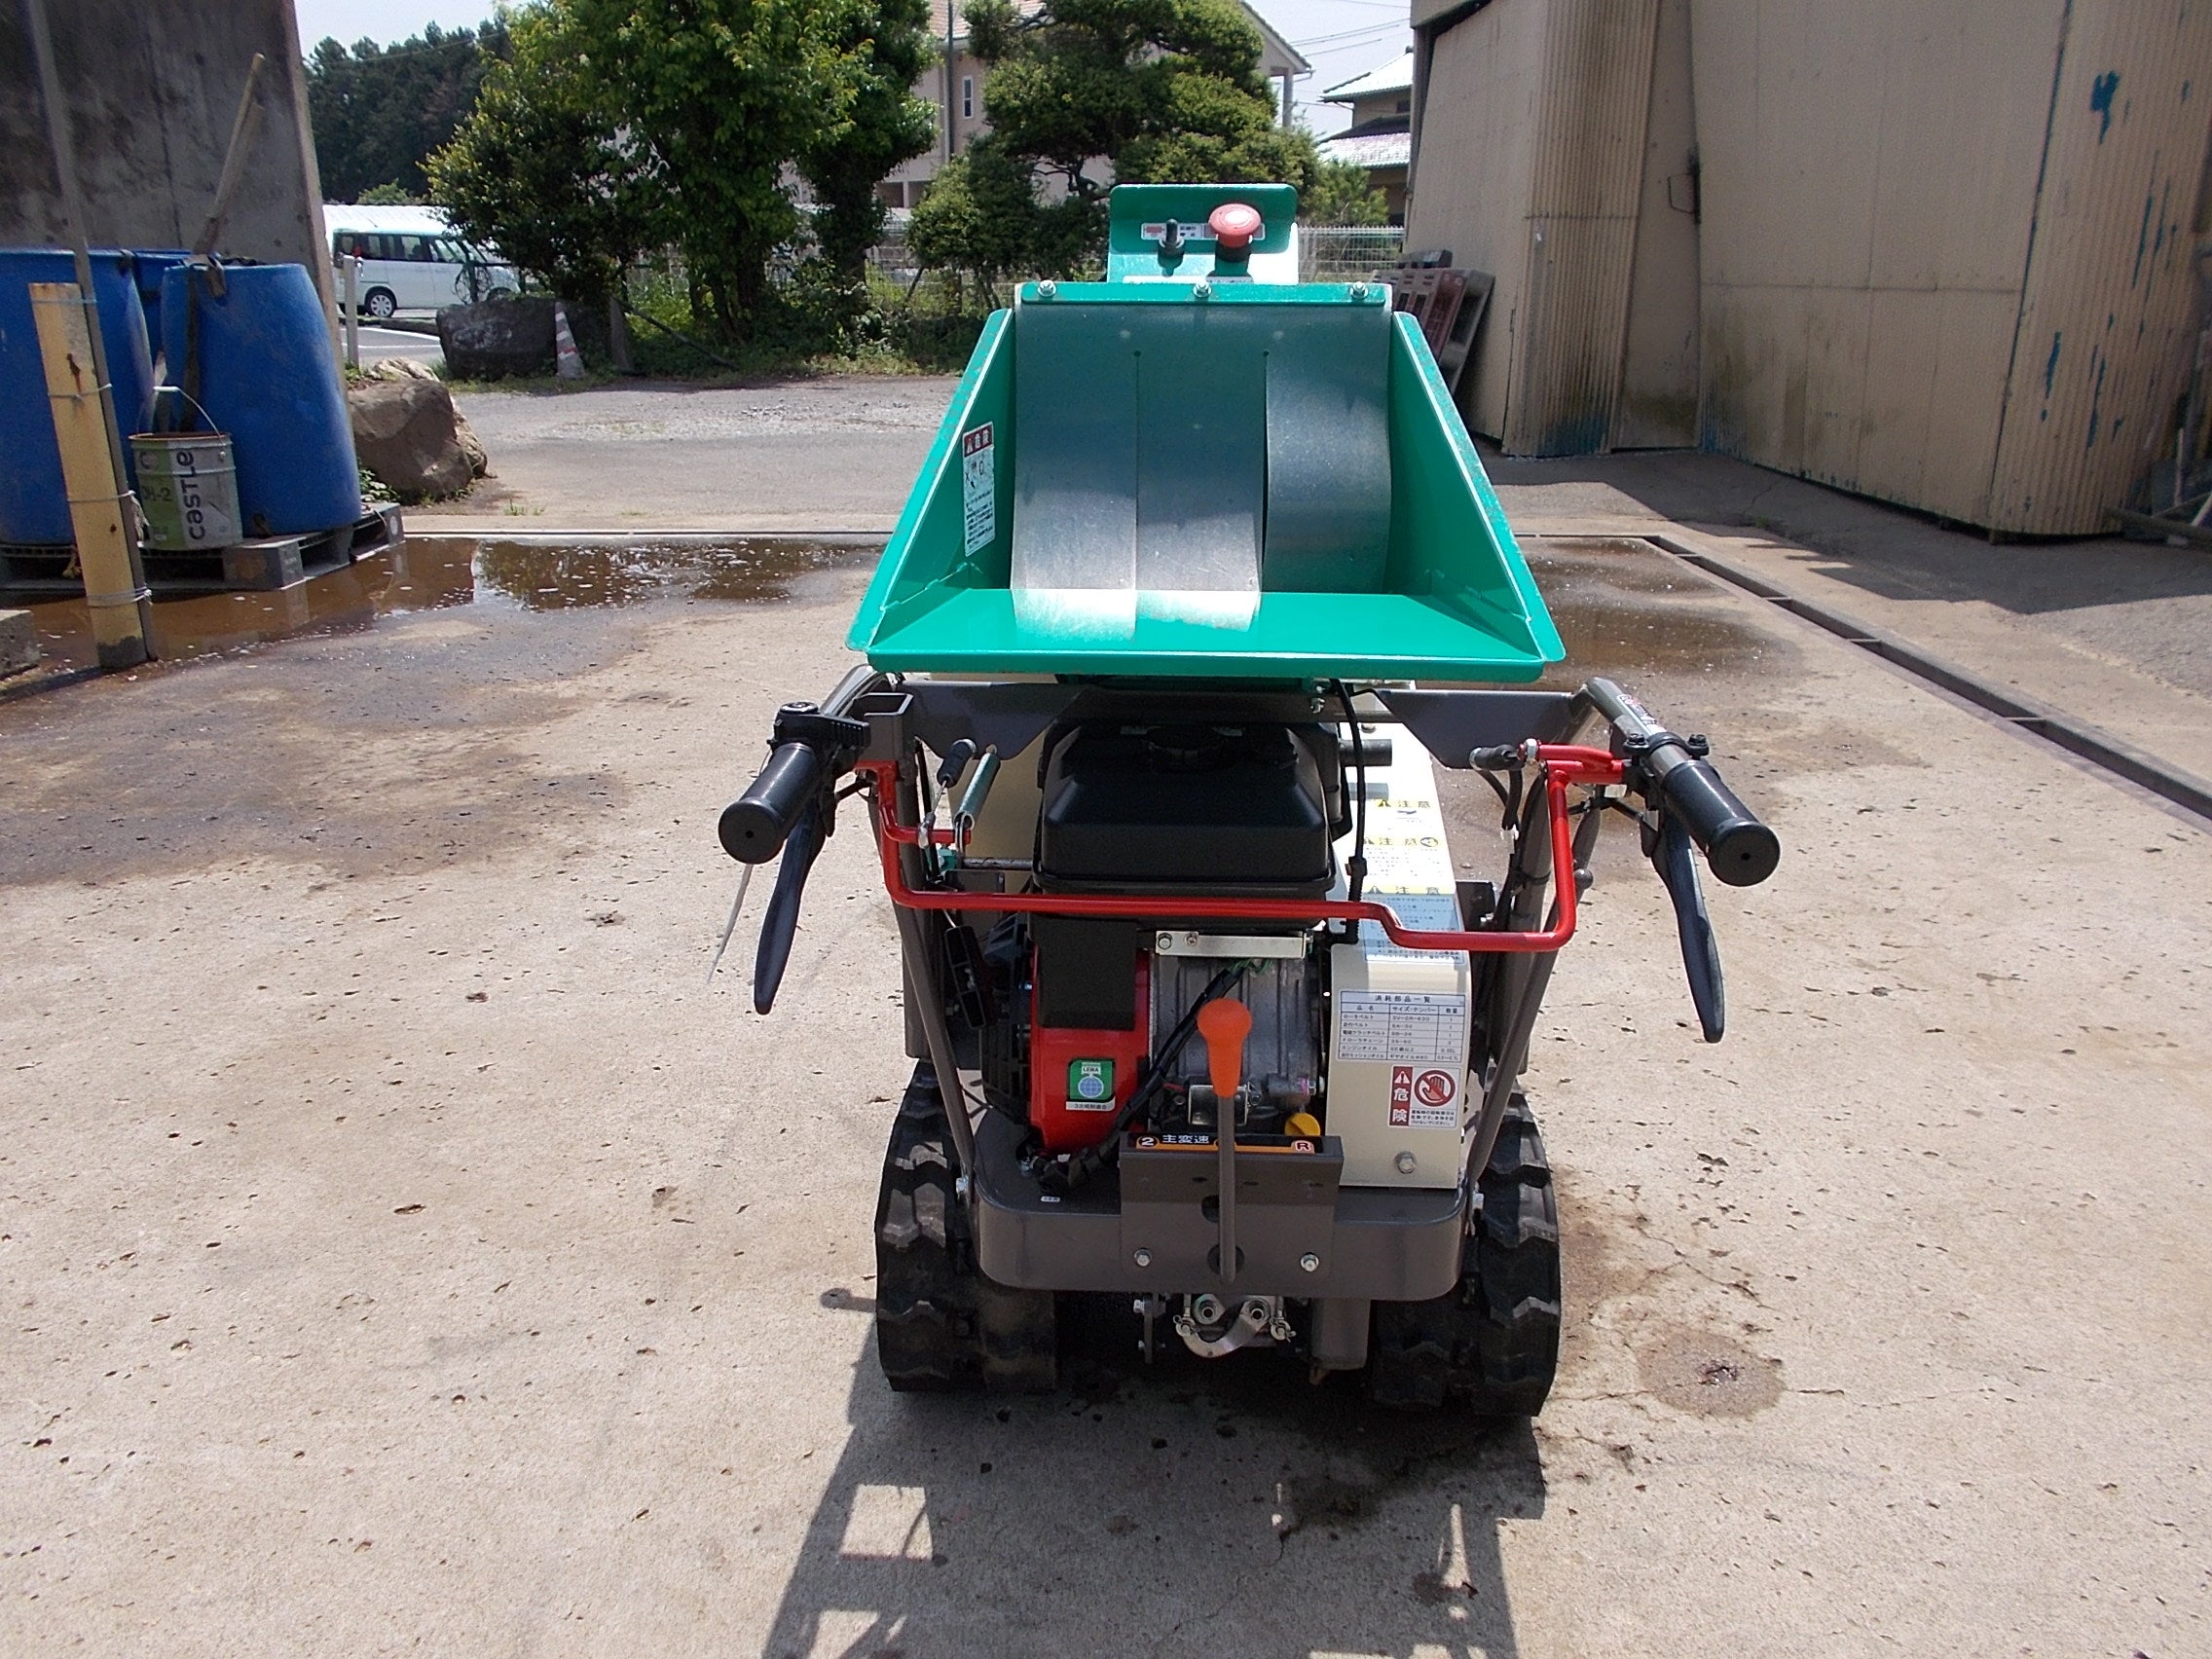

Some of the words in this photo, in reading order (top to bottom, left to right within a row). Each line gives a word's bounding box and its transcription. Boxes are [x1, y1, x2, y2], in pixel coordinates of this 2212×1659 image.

[1392, 1088, 1410, 1123] 危険
[1141, 1137, 1156, 1146] 2
[1161, 1134, 1209, 1145] 主変速
[1296, 1142, 1310, 1152] R
